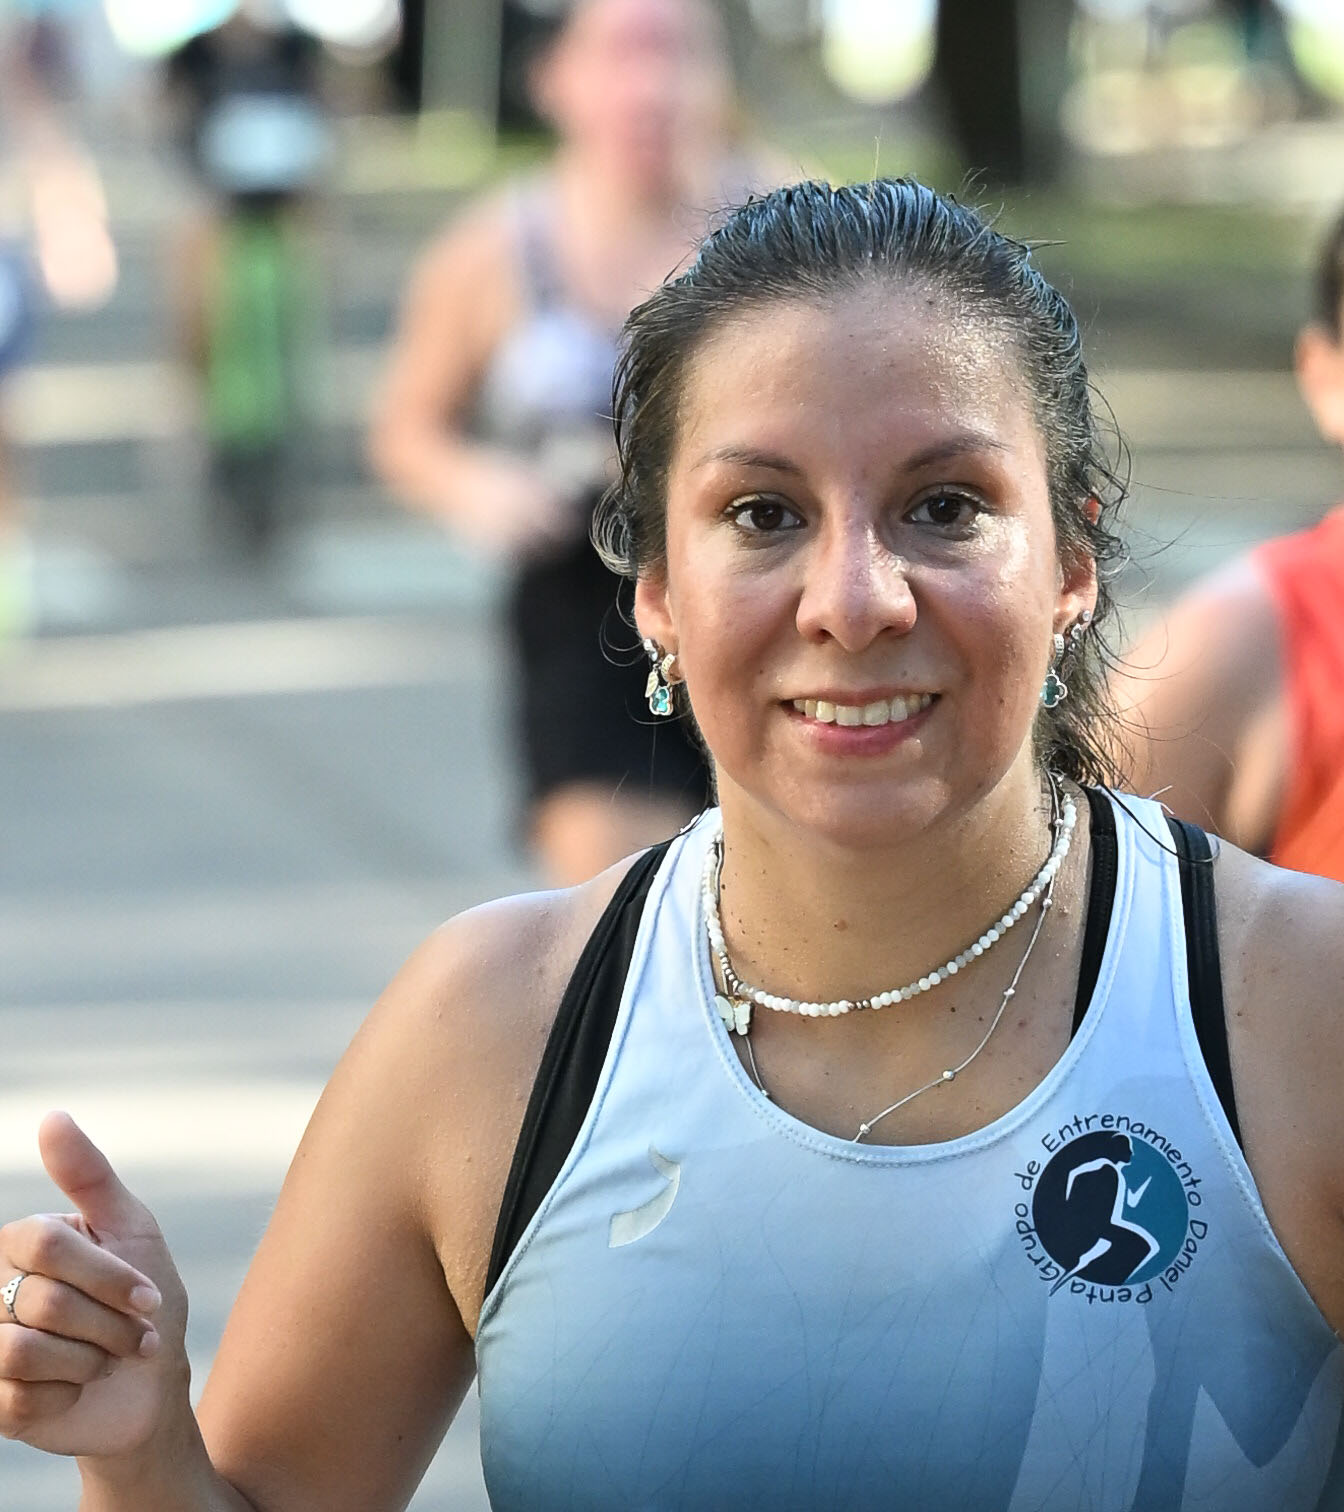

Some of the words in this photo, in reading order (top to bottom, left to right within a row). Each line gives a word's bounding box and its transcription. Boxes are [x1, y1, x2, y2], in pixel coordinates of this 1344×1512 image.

[1014, 1160, 1041, 1191] de
[1041, 1113, 1202, 1207] Entrenamiento
[1014, 1202, 1061, 1282] Grupo
[1159, 1219, 1208, 1292] Daniel
[1070, 1279, 1153, 1305] Penta
